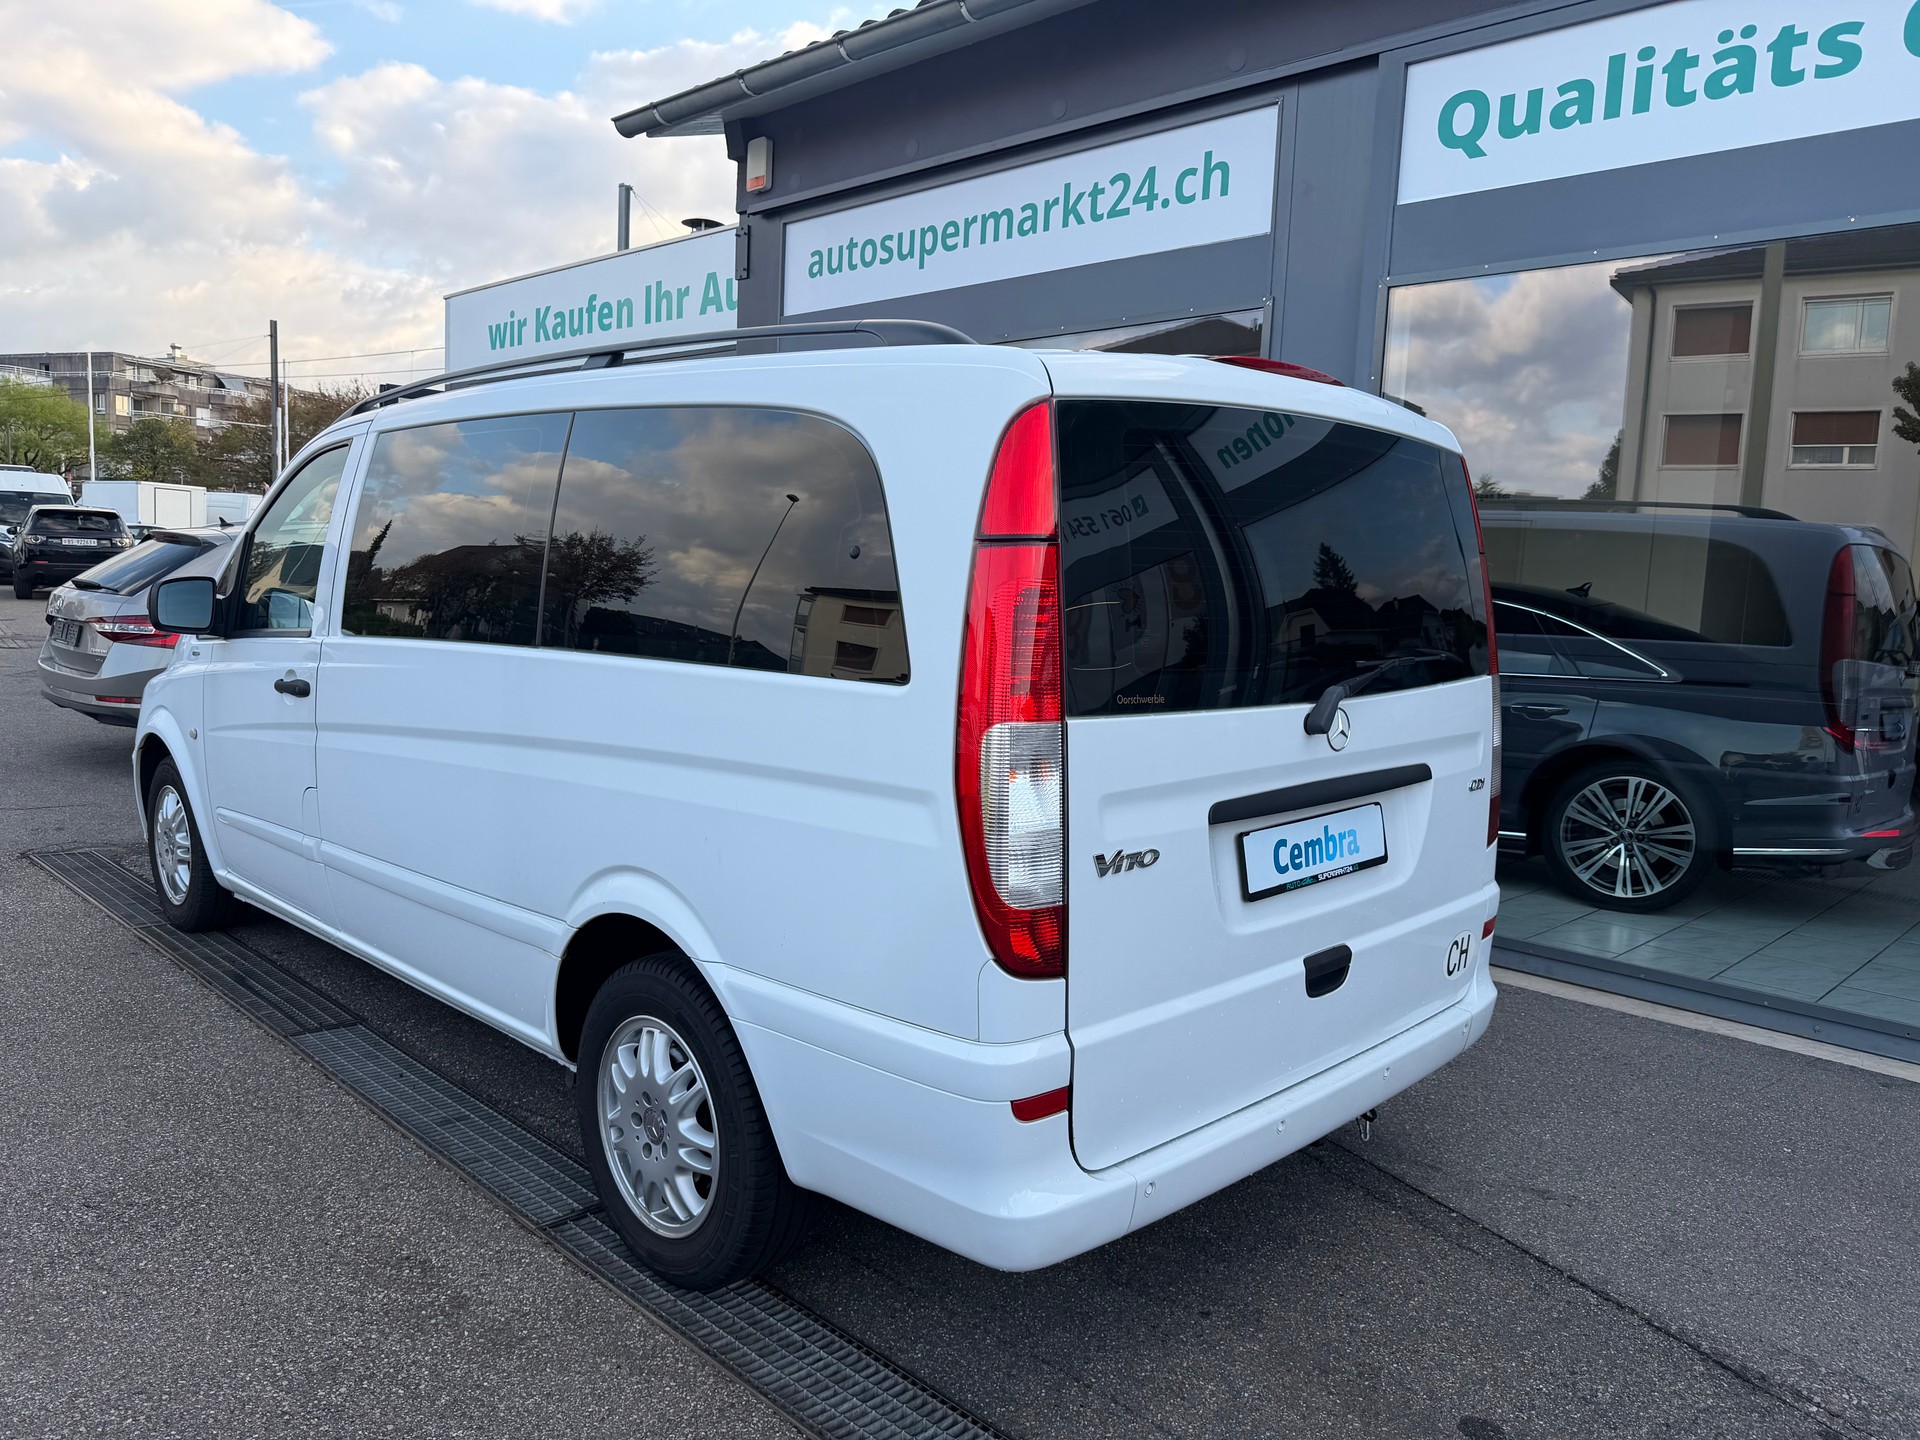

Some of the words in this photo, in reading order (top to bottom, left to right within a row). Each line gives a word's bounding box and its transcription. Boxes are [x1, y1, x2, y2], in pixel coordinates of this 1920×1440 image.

[1437, 20, 1865, 160] Qualitäts
[807, 150, 1230, 279] autosupermarkt24.ch
[488, 310, 528, 351] wir
[535, 293, 634, 342] Kaufen
[644, 280, 690, 325] Ihr
[1273, 824, 1360, 875] Cembra
[1446, 934, 1471, 977] CH
